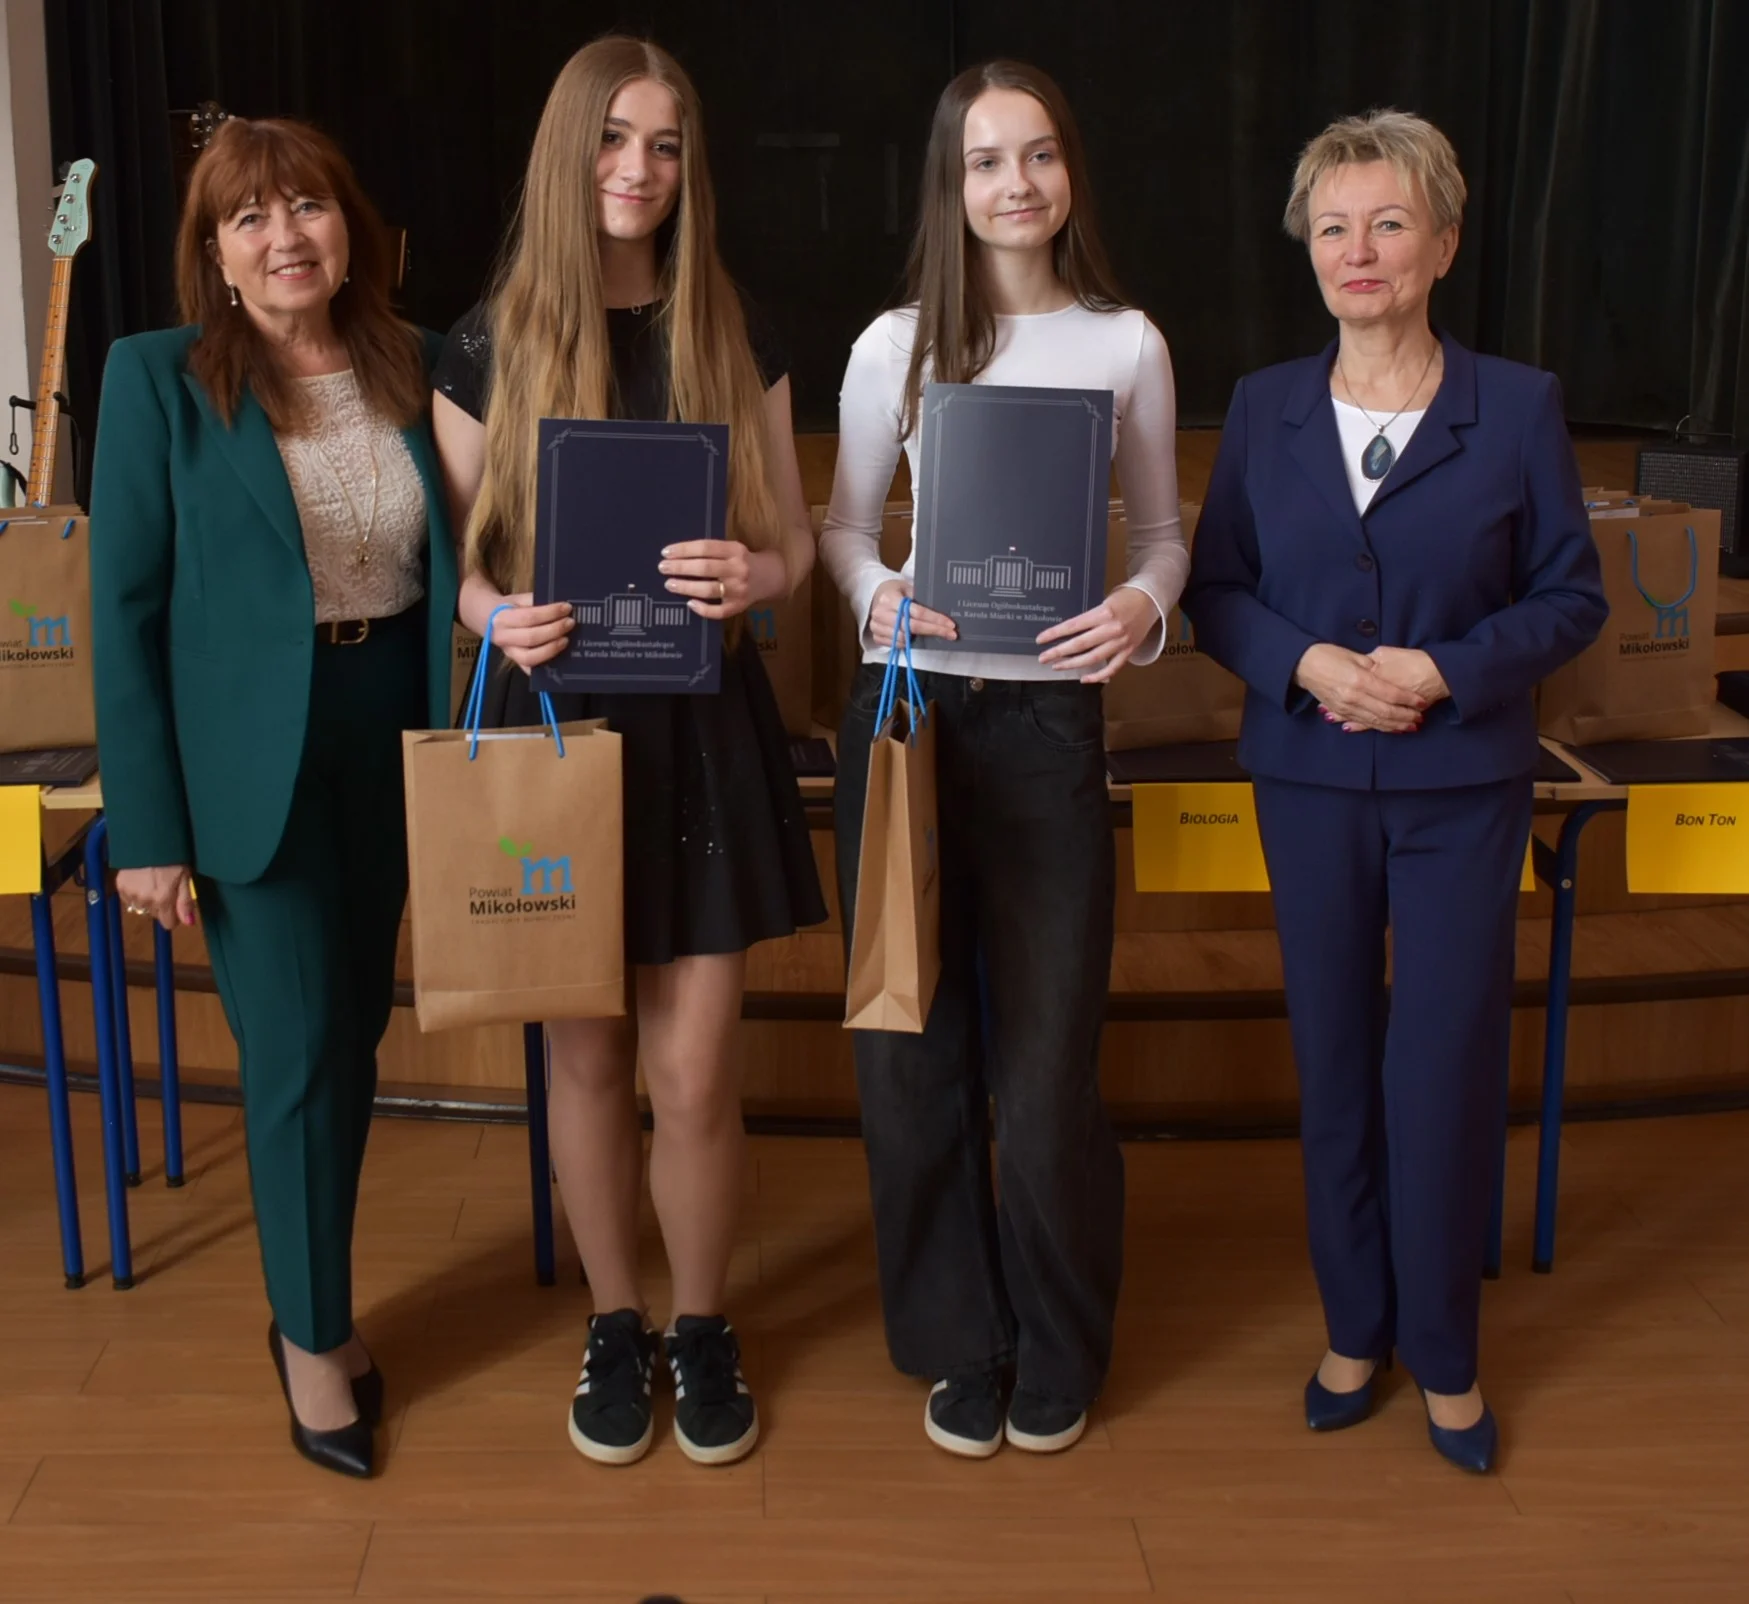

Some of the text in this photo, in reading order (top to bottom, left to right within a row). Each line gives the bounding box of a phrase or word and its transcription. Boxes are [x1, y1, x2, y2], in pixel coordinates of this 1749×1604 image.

[962, 600, 989, 608] Liceum
[1620, 638, 1689, 654] Mikołowski
[0, 647, 74, 662] ikołowski
[1179, 811, 1239, 825] BIOLOGIA
[1675, 813, 1737, 826] BON TON
[469, 886, 513, 899] Powiat
[469, 895, 576, 915] Mikołowski
